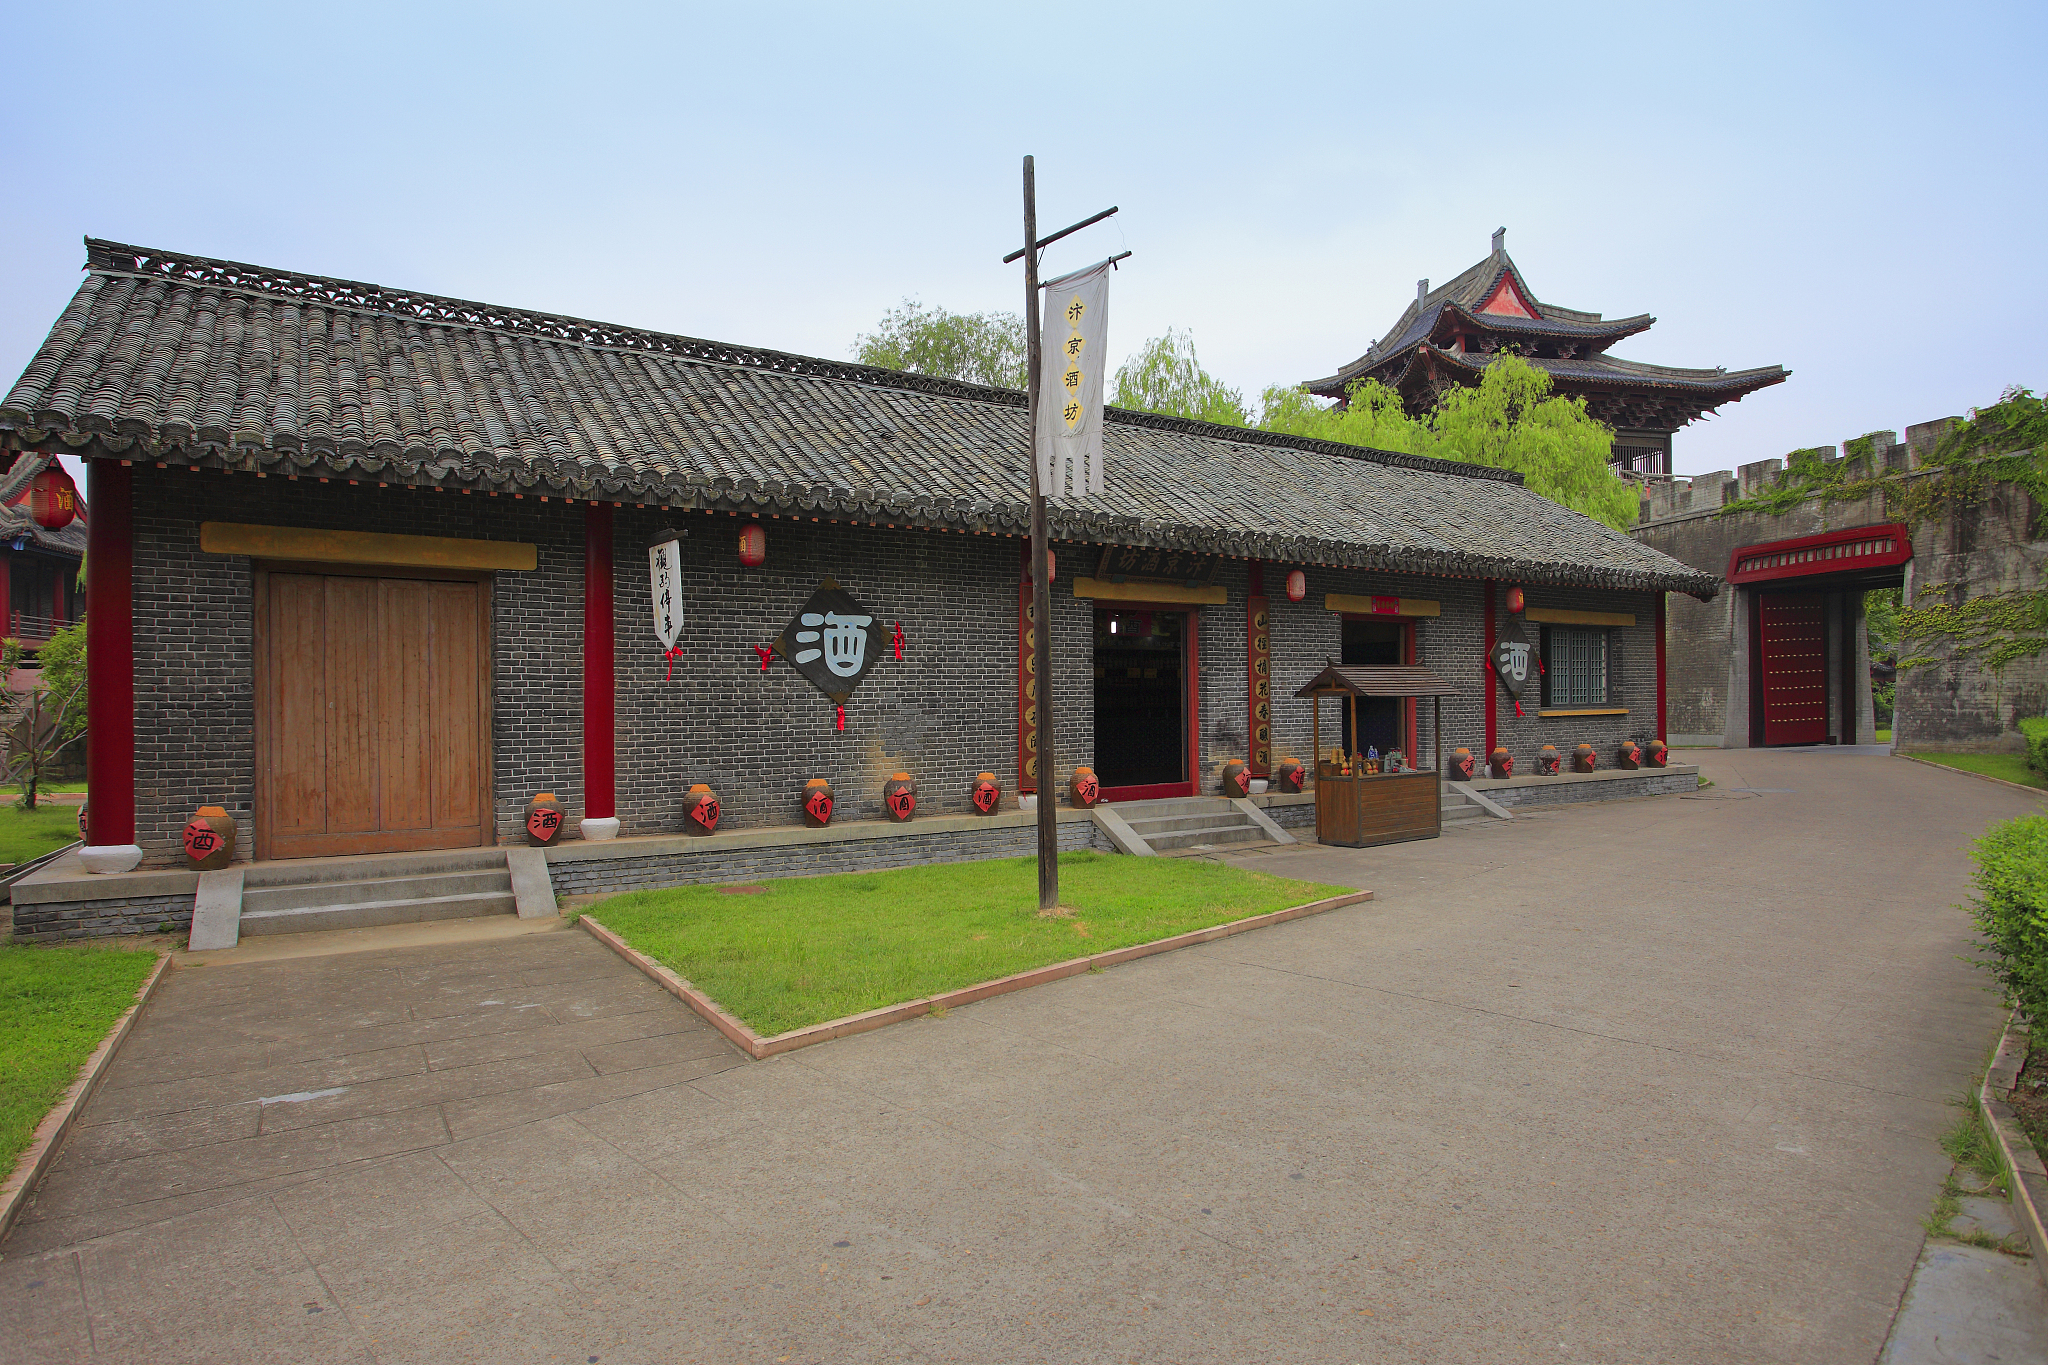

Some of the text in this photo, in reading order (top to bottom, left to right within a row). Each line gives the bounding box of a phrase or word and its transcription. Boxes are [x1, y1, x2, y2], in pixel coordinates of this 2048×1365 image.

[1064, 302, 1083, 421] 汴京酒坊
[56, 486, 73, 511] 酒
[1118, 548, 1207, 578] 汴京酒坊
[795, 610, 872, 677] 酒
[1500, 641, 1531, 681] 酒
[978, 788, 994, 805] 酒
[1082, 780, 1097, 797] 酒
[700, 800, 718, 824] 酒
[814, 797, 828, 814] 酒
[893, 793, 910, 811] 酒
[533, 812, 558, 829] 酒
[185, 825, 216, 851] 酒
